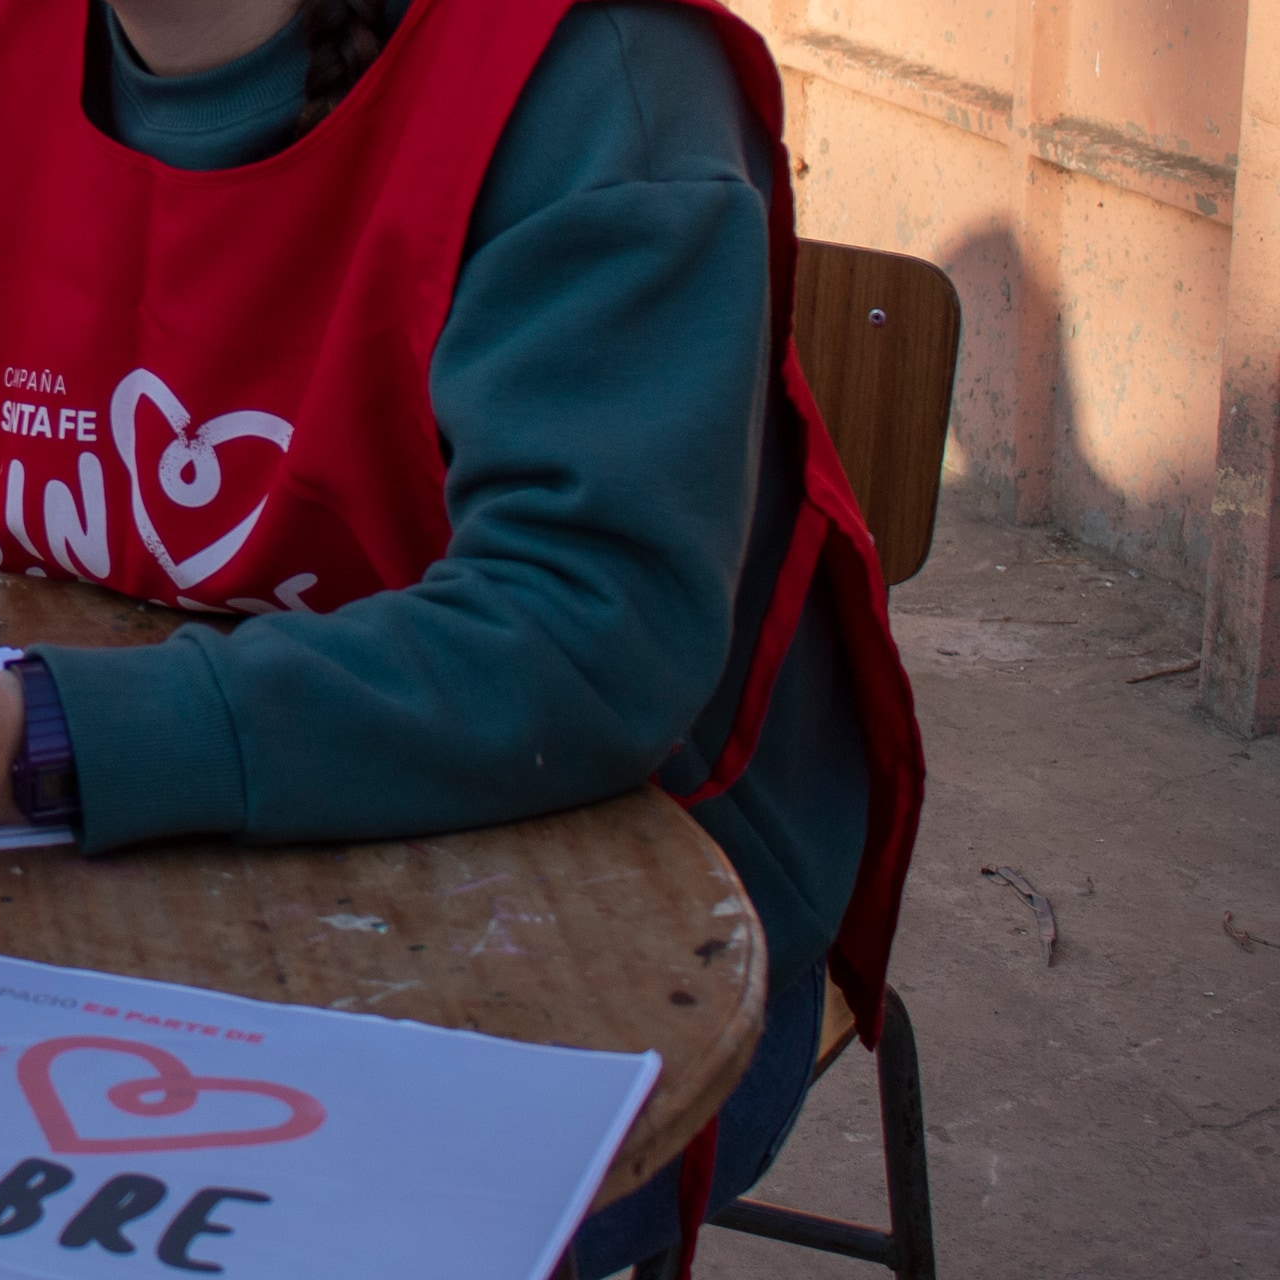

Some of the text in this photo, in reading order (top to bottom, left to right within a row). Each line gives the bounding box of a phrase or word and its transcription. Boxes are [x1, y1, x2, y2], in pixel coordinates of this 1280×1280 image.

[58, 407, 97, 442] FE
[82, 1001, 120, 1018] ES
[123, 1009, 222, 1037] PARTE
[225, 1027, 265, 1045] DE
